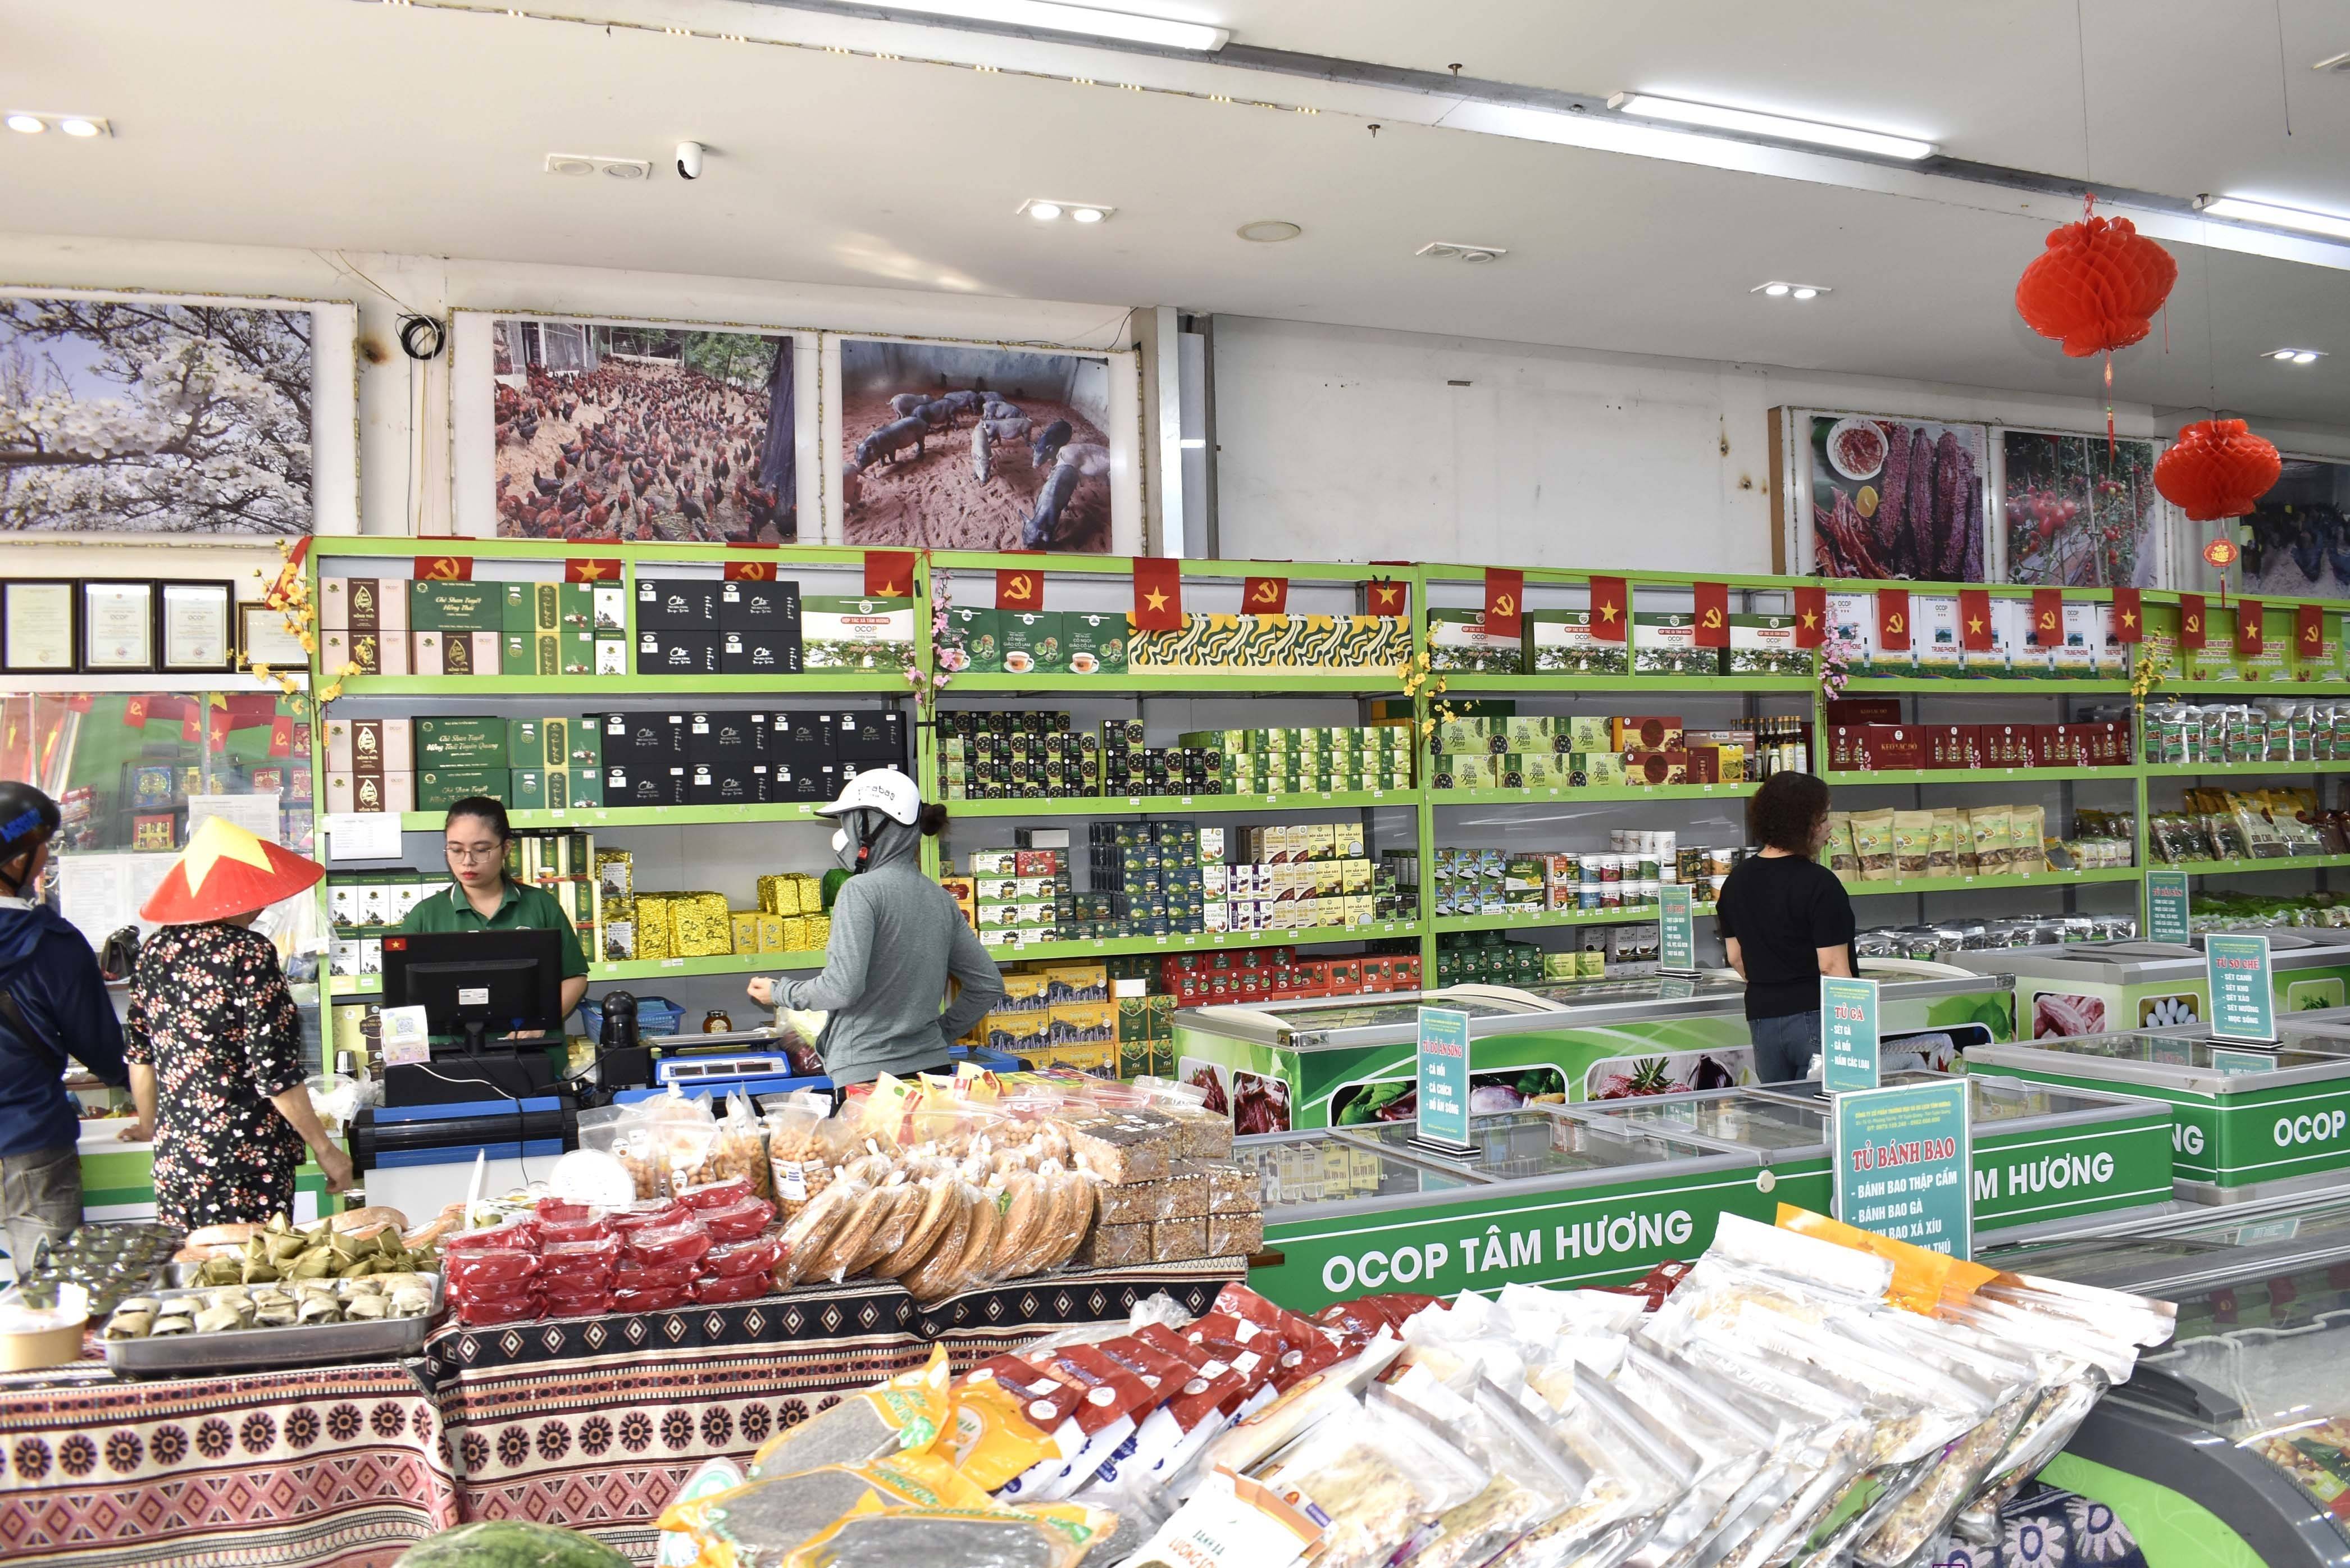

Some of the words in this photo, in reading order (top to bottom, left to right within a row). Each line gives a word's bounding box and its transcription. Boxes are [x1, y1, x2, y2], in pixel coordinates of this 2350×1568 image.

[2216, 955, 2228, 969] TỦ
[2242, 956, 2260, 970] CHẾ
[1834, 1002, 1848, 1020] TỦ
[1850, 1005, 1865, 1022] GÀ
[1834, 1024, 1843, 1034] SÉT
[1843, 1024, 1851, 1035] GÀ
[1422, 1036, 1430, 1054] TỦ
[1438, 1039, 1447, 1055] ĂN
[1447, 1038, 1462, 1058] SỐNG
[1834, 1039, 1841, 1051] GÀ
[1429, 1064, 1436, 1076] CÁ
[1847, 1056, 1857, 1068] CÁC
[1858, 1059, 1870, 1070] LOẠI
[1429, 1082, 1436, 1093] CÁ
[1445, 1100, 1459, 1115] SỐNG
[2274, 1110, 2347, 1147] OCOP
[1852, 1139, 1874, 1172] TỦ
[1877, 1138, 1921, 1169] BÁNH
[1923, 1136, 1956, 1163] BAO
[1857, 1181, 1885, 1198] BÁNH
[1887, 1179, 1906, 1195] BAO
[1909, 1173, 1933, 1192] THẬP
[1935, 1167, 1957, 1187] CẨM
[2009, 1152, 2115, 1196] HƯƠNG
[1859, 1206, 1886, 1223] BÁNH
[1888, 1203, 1907, 1219] BAO
[1910, 1198, 1923, 1214] GÀ
[1889, 1225, 1908, 1239] BAO
[1910, 1220, 1924, 1237] XÁ
[1926, 1218, 1942, 1233] XÍU
[1322, 1243, 1448, 1292] OCOP
[1460, 1224, 1541, 1274] TÂM
[1555, 1210, 1693, 1260] HƯƠNG
[1933, 1238, 1951, 1255] THÚ
